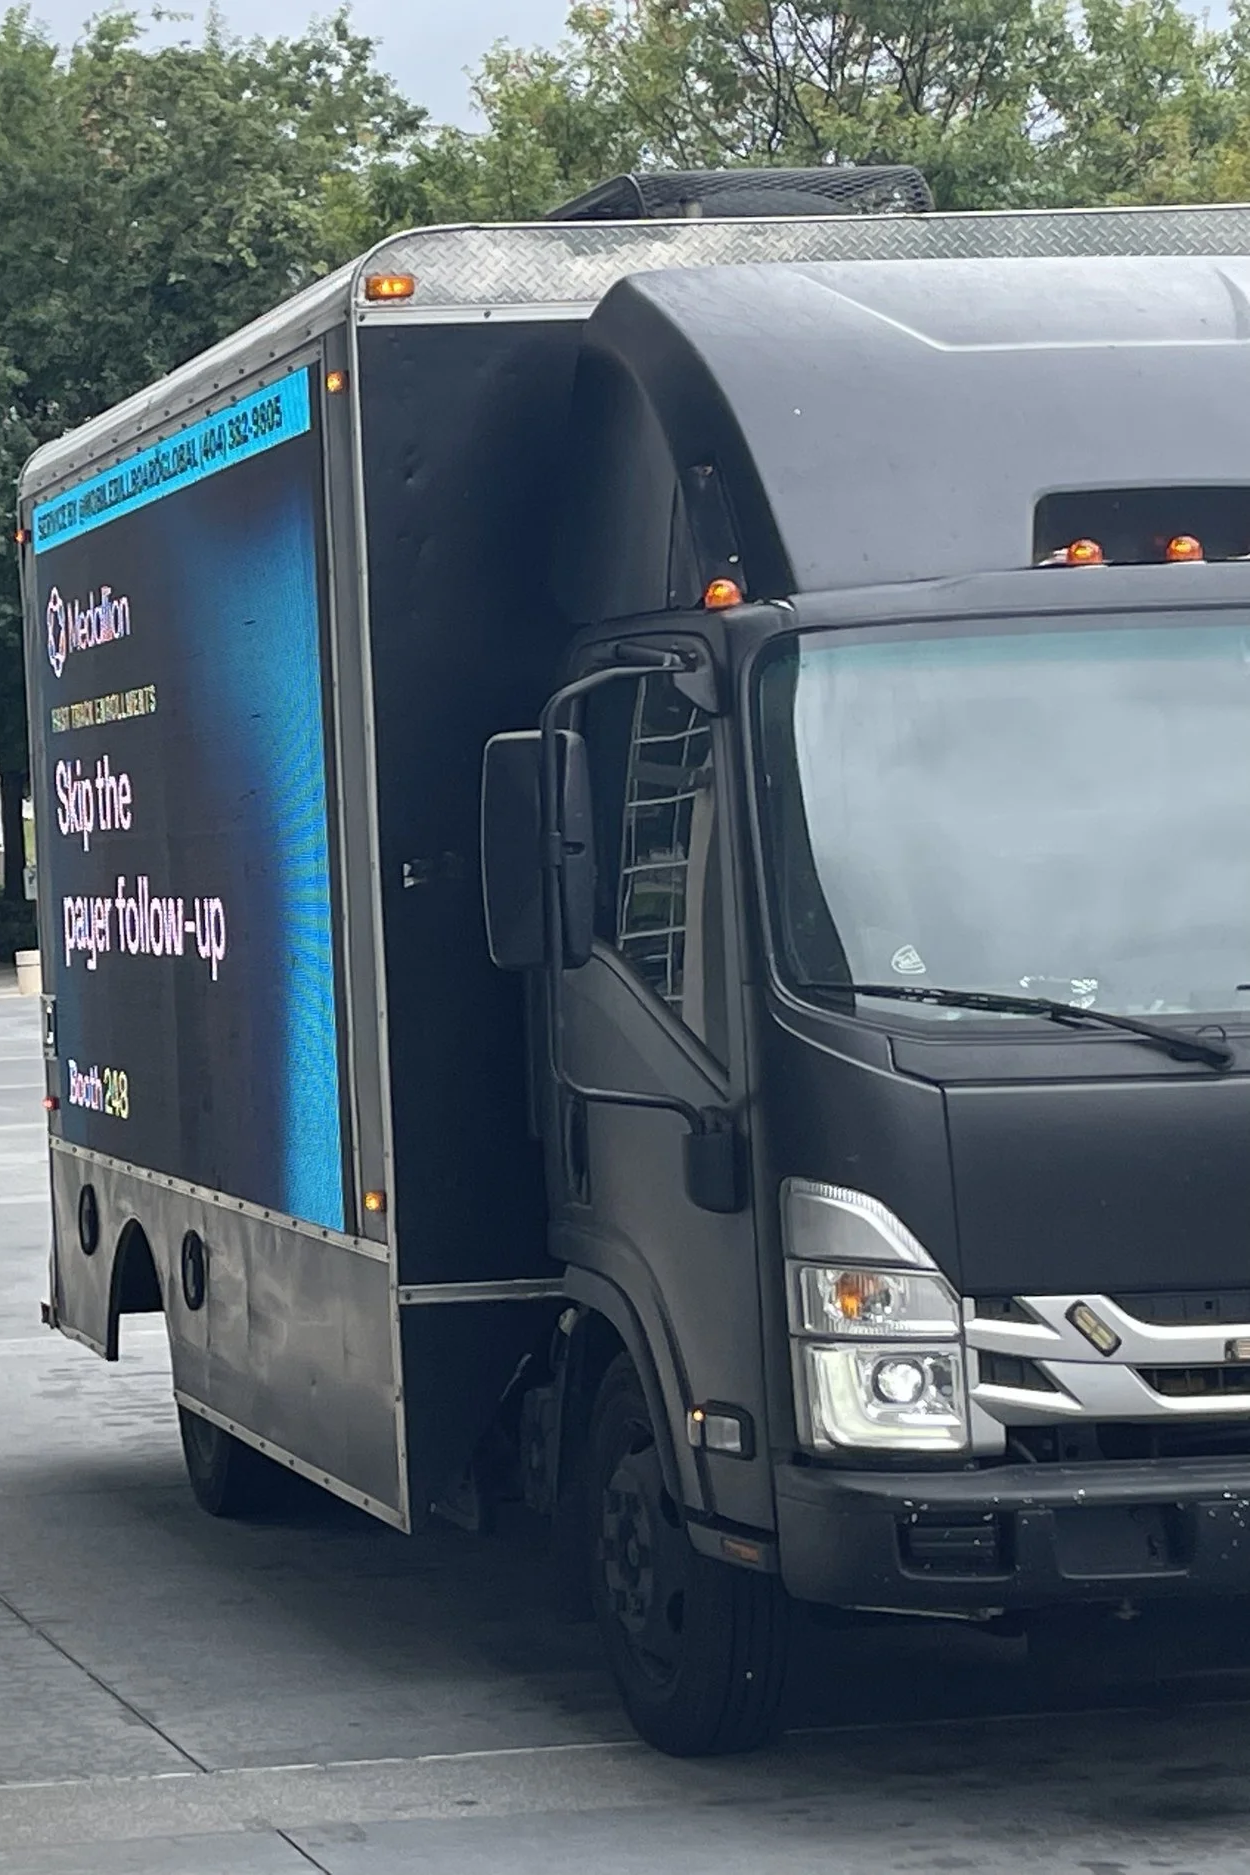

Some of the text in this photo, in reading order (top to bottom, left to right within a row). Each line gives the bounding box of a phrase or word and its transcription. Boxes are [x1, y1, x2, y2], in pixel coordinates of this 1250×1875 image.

[37, 503, 66, 541] SERVICE
[66, 497, 77, 527] BY
[199, 421, 227, 471] (404)
[52, 684, 156, 733] FAST TRACK ENROLLMENTS
[55, 754, 132, 852] Skip the
[62, 875, 226, 981] payer follow-up
[68, 1059, 129, 1120] Booth 248
